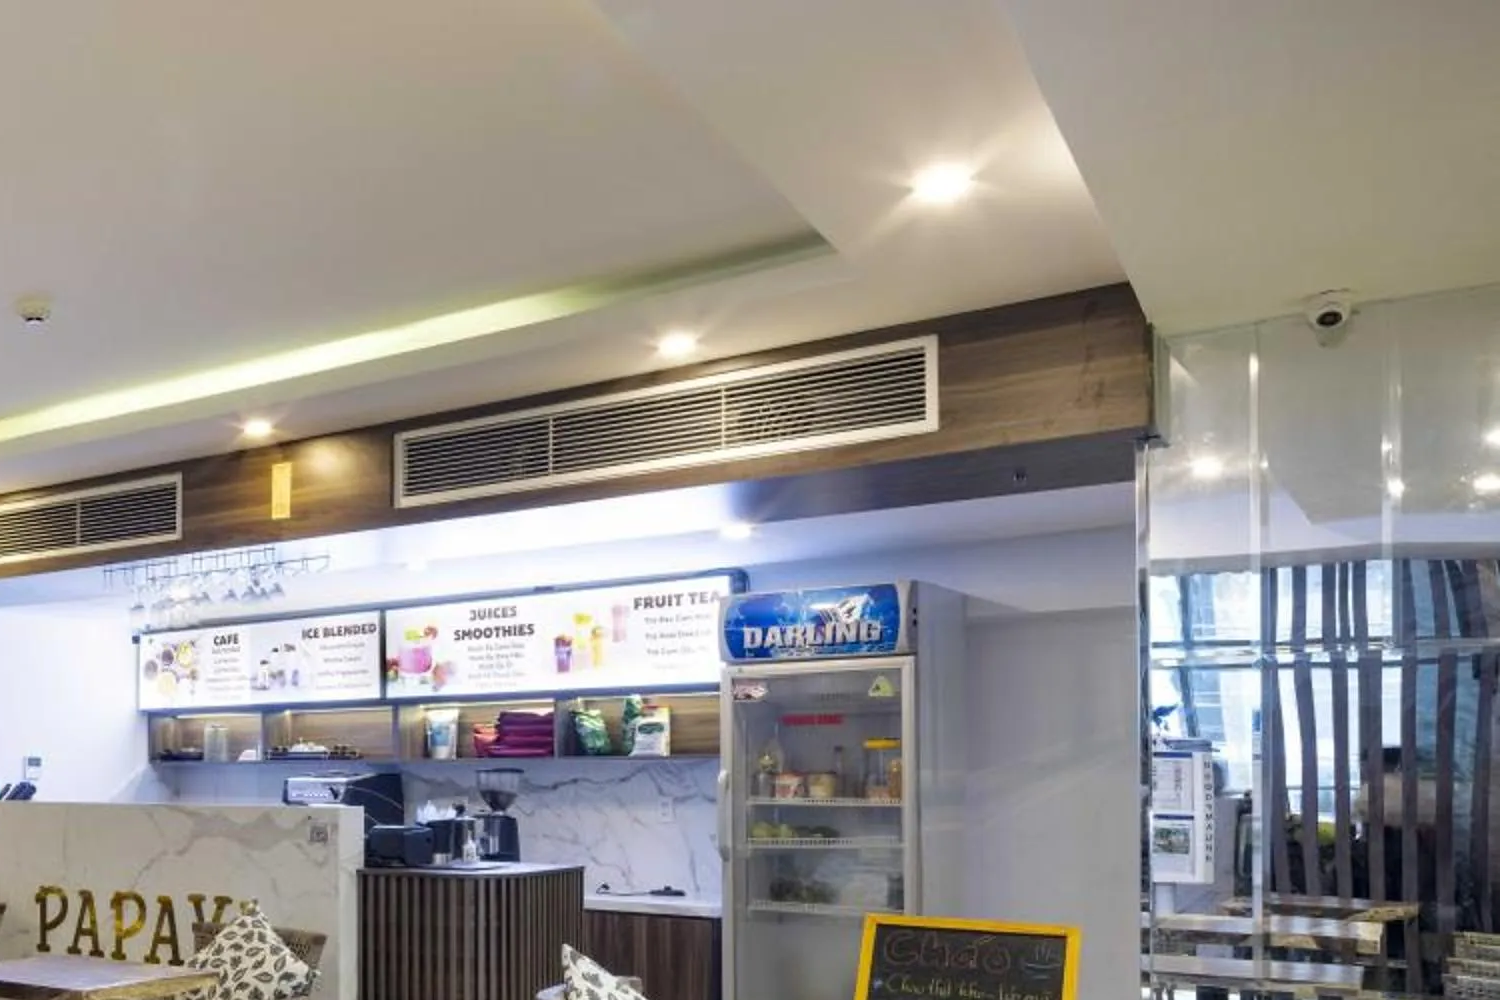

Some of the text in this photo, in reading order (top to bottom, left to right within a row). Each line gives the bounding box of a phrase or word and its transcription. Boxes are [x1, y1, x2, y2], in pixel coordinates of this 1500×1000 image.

[633, 589, 720, 610] FRUIT TEA
[469, 606, 517, 622] JUICES
[302, 623, 377, 640] ICE BLENDED
[453, 623, 535, 641] SMOOTHIES
[743, 619, 881, 649] DARLING
[35, 885, 250, 966] PAPAY
